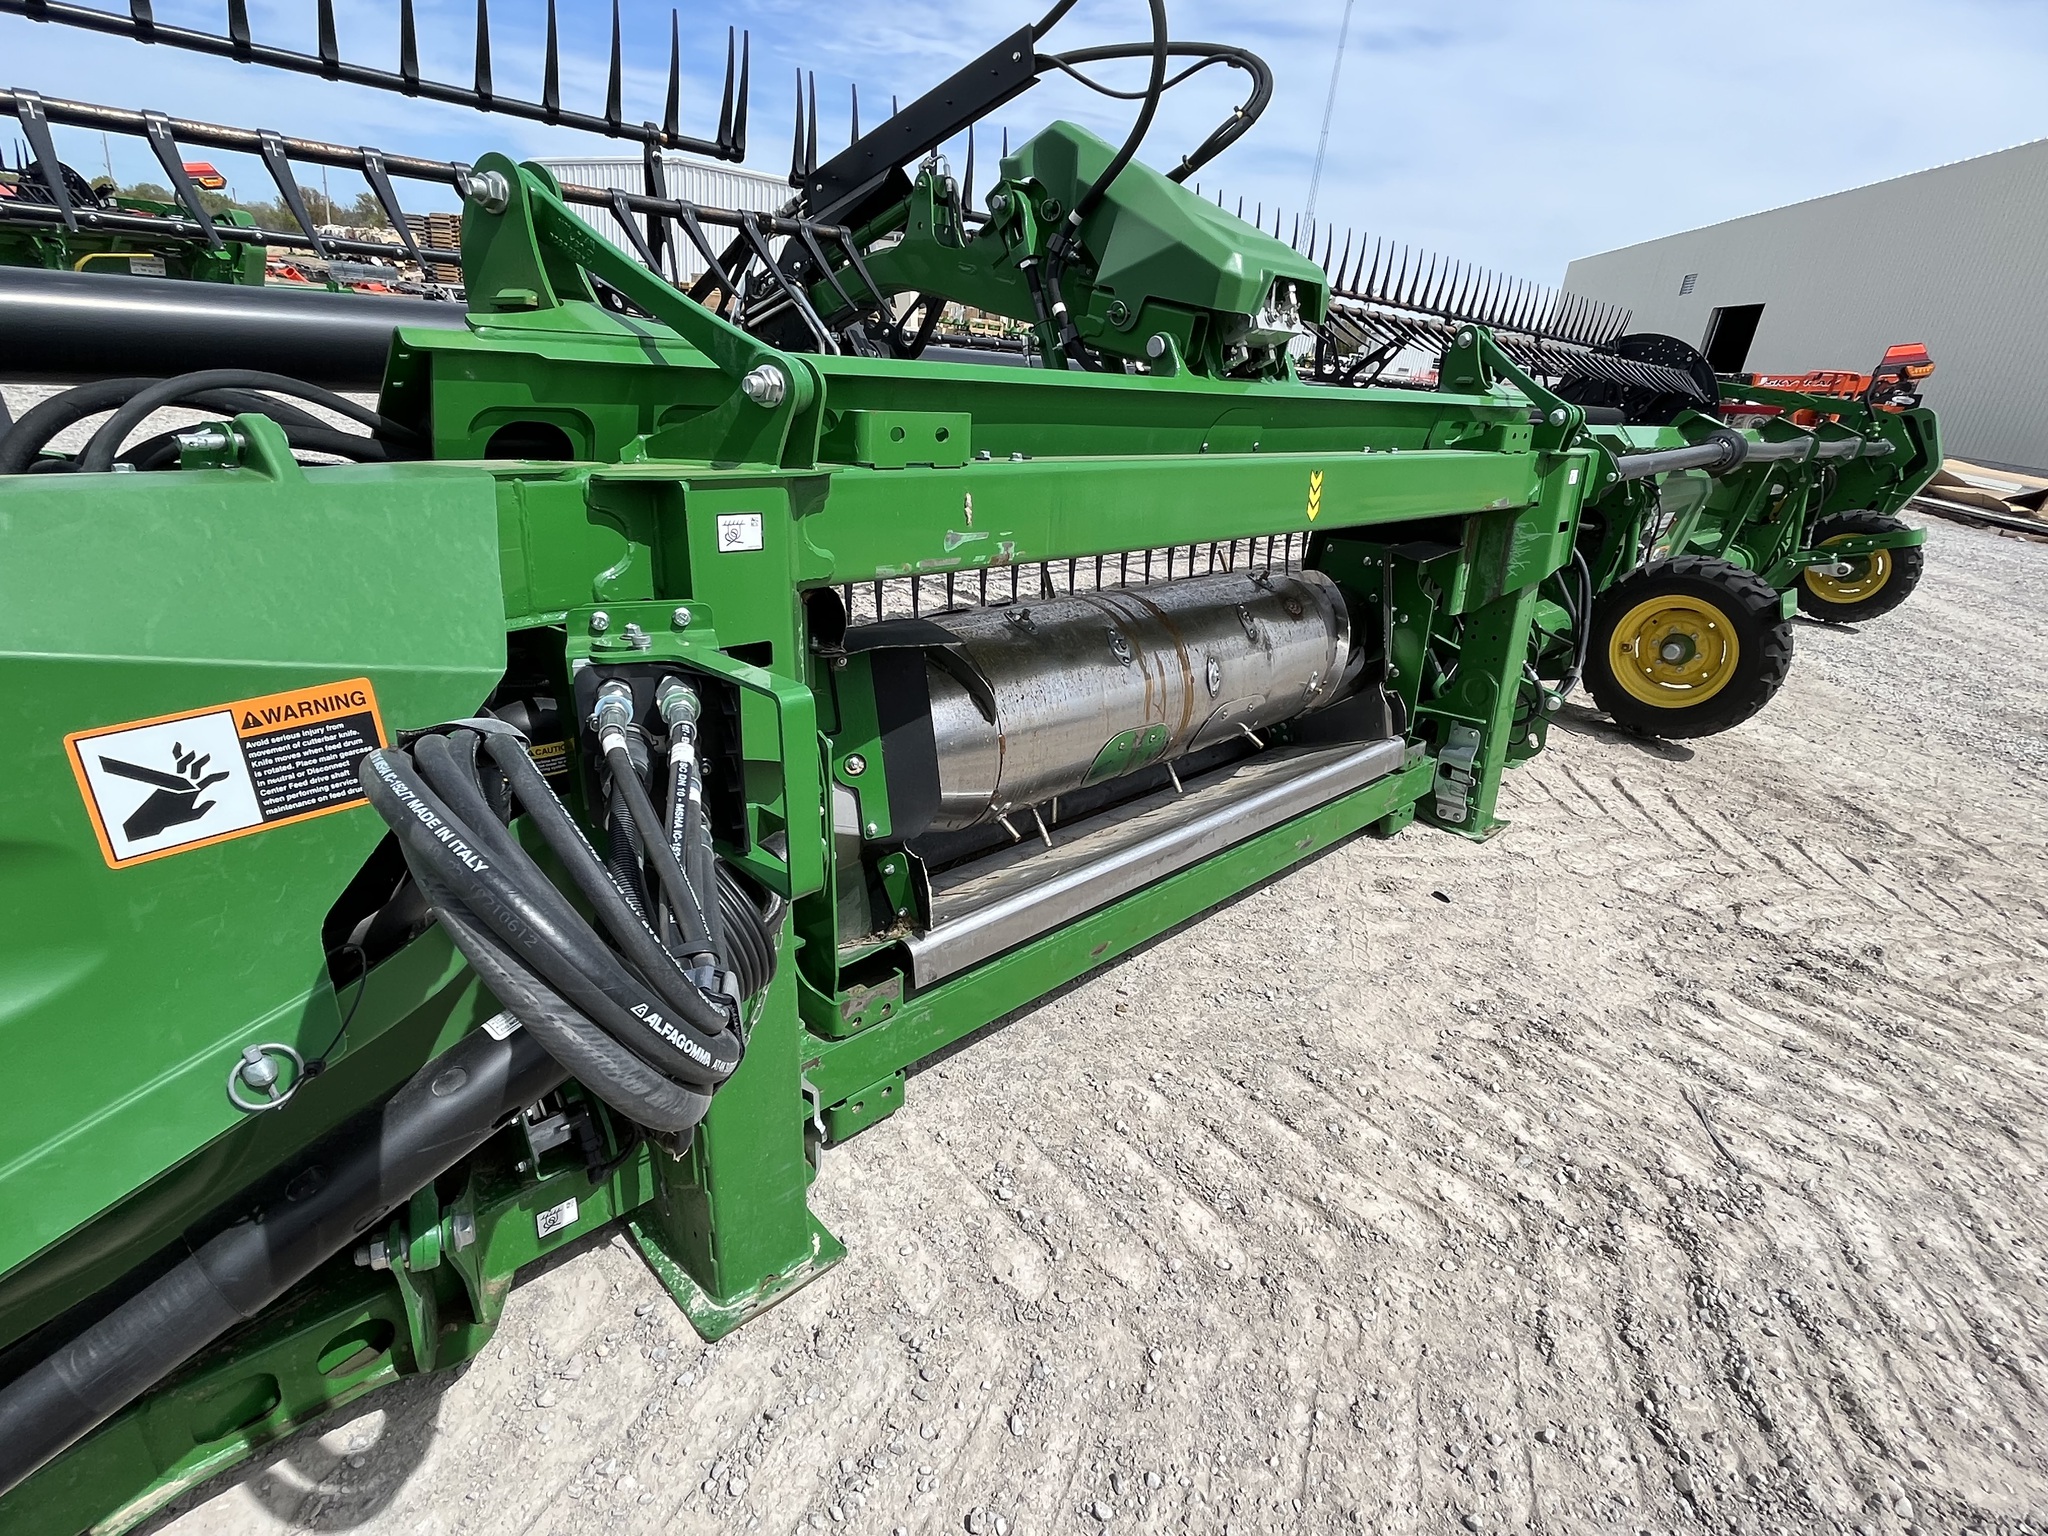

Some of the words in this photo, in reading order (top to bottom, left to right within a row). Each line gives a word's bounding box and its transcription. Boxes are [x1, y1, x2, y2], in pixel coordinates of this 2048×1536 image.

[261, 691, 367, 725] WARNING
[246, 739, 269, 749] Avoid
[271, 732, 301, 744] serious
[302, 727, 325, 739] injury
[326, 722, 344, 732] from
[249, 744, 291, 759] movement
[292, 741, 300, 749] of
[302, 734, 337, 747] cutterbar
[339, 730, 360, 739] knife.
[251, 758, 273, 769] Knife
[275, 753, 301, 764] moves
[303, 747, 323, 757] when
[325, 743, 342, 752] feed
[343, 738, 363, 747] drum
[264, 763, 294, 776] rotated.
[296, 758, 318, 768] Place
[319, 754, 338, 763] main
[340, 745, 373, 759] gearcase
[260, 785, 287, 796] Center
[288, 780, 308, 790] Feed
[309, 775, 330, 785] drive
[331, 770, 350, 780] shaft
[267, 772, 295, 785] neutral
[297, 770, 305, 778] or
[307, 760, 350, 775] Disconnect
[676, 774, 688, 787] DN
[263, 797, 285, 806] when
[286, 786, 329, 802] performing
[331, 778, 358, 789] service
[266, 799, 316, 815] maintenance
[329, 789, 346, 799] feed
[675, 787, 686, 798] 10
[382, 772, 416, 801] IC-152/7
[406, 798, 442, 830] MADE
[433, 826, 456, 843] IN
[447, 839, 489, 873] ITALY
[673, 803, 686, 832] MSHA
[642, 1012, 712, 1068] ALFAGOMMA
